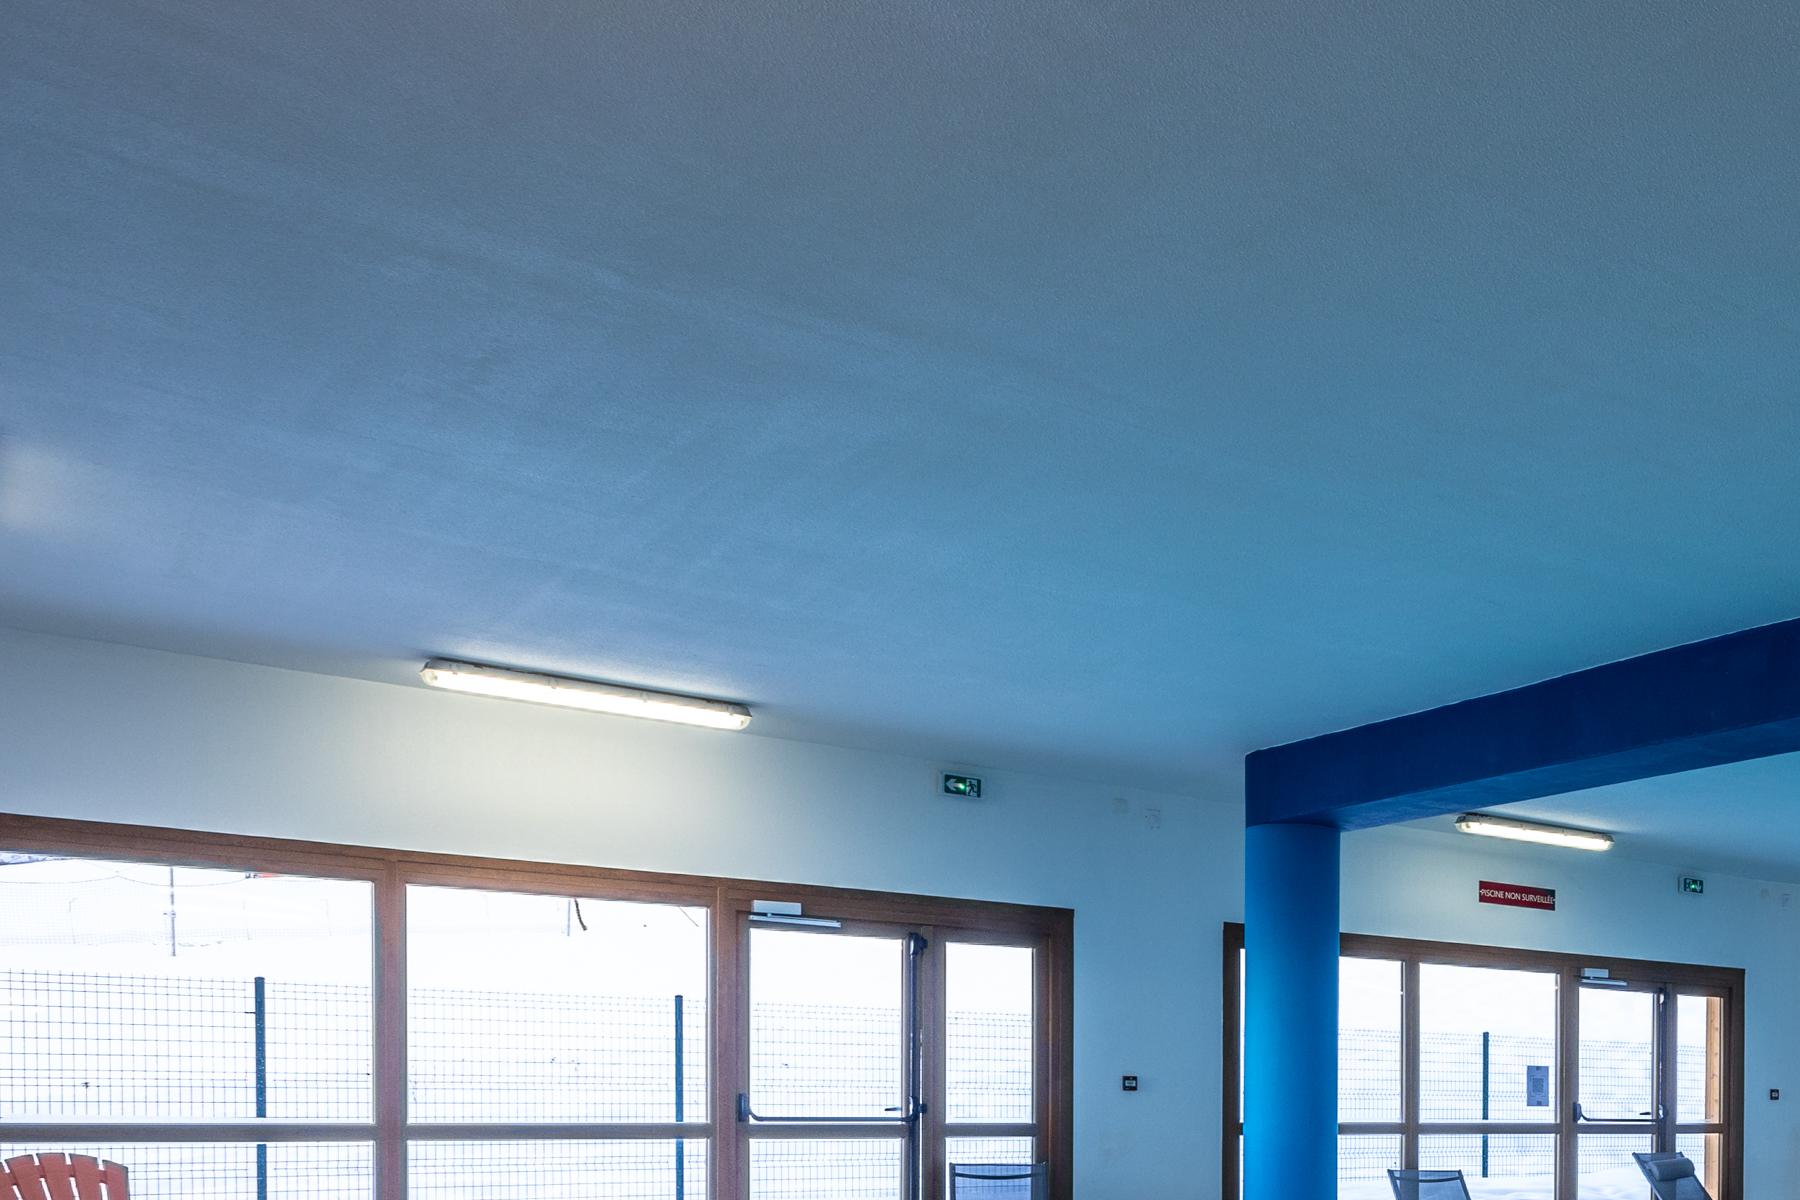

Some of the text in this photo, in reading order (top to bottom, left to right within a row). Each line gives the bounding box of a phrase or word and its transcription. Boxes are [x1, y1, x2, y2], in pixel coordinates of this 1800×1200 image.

[1481, 889, 1554, 905] PISCINE NON SURVEILLÉE
